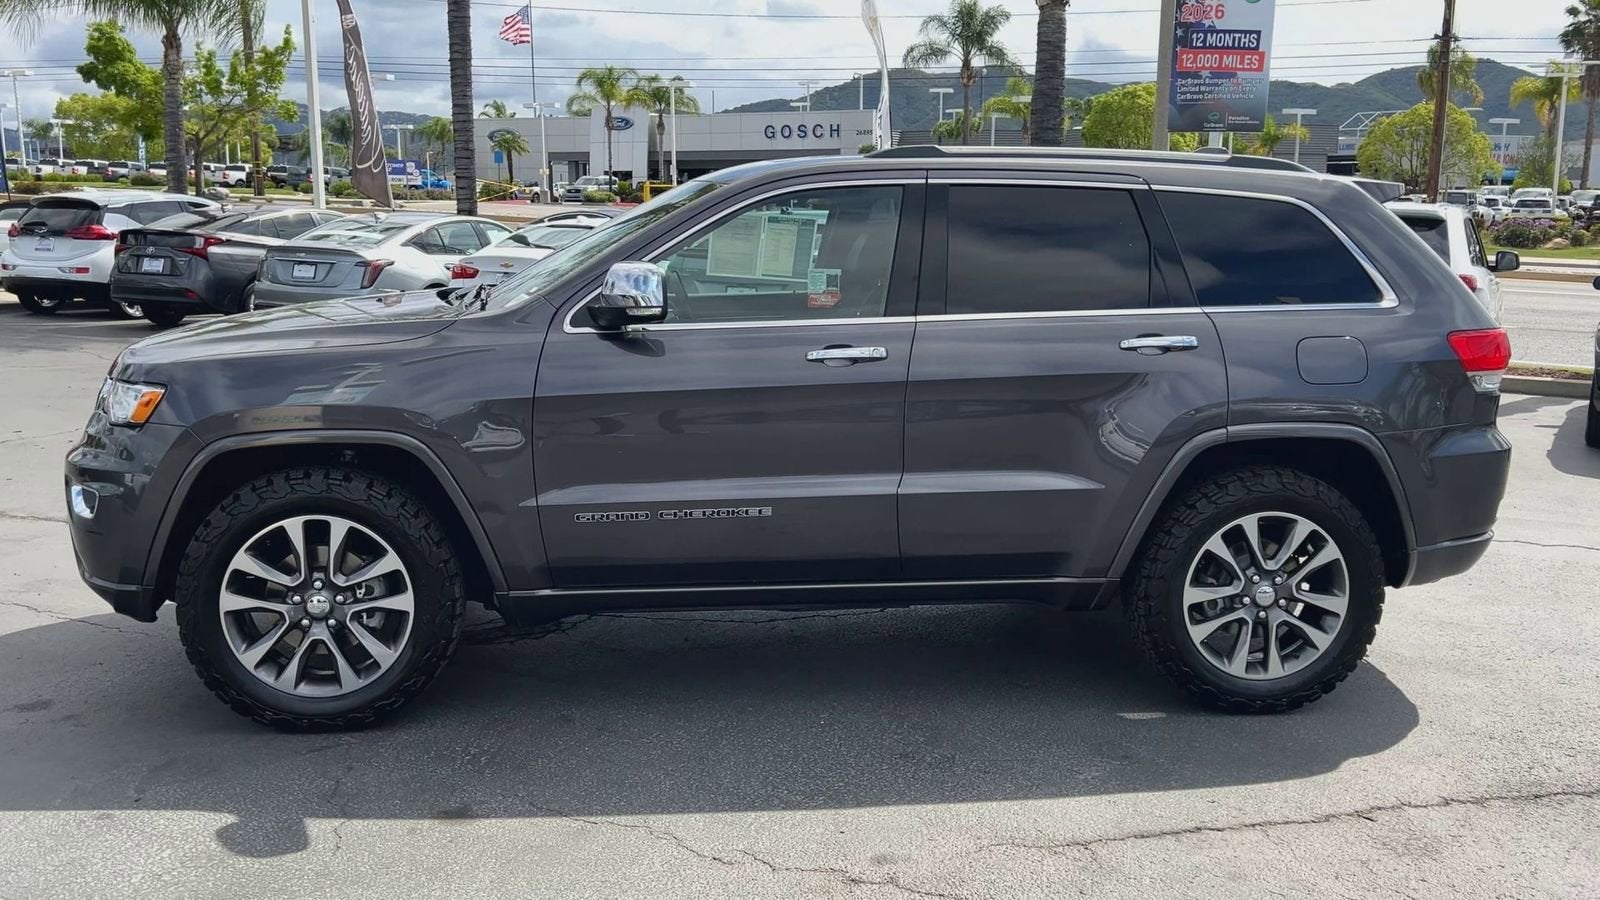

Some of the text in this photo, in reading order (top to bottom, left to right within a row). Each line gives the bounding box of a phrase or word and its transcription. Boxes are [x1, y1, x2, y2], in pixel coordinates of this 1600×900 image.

[1181, 4, 1225, 21] 2026
[1191, 33, 1258, 48] 12 MONTHS
[1182, 54, 1259, 69] 12,000 MILES
[1200, 86, 1228, 94] Warranty
[764, 124, 840, 139] GOSCH
[574, 506, 773, 523] GRAND CHEROKEE
